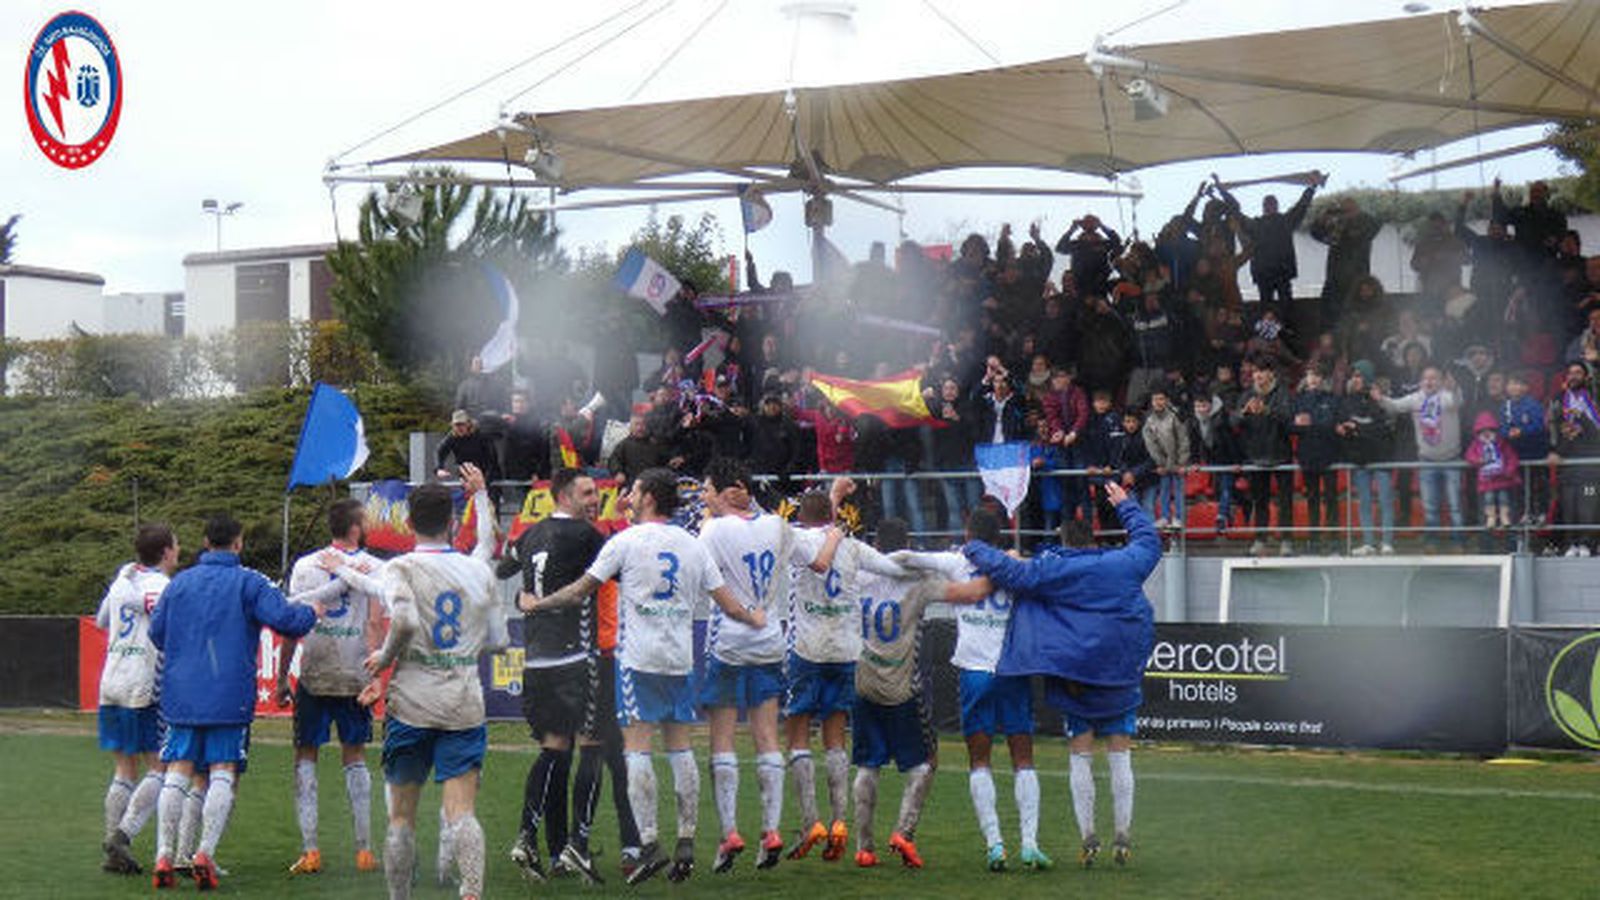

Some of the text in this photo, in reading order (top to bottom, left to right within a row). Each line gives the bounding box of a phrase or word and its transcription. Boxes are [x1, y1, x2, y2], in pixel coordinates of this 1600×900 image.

[531, 551, 549, 598] 1
[652, 551, 681, 600] 3
[742, 549, 777, 602] 18
[433, 590, 463, 650] 8
[860, 596, 901, 643] 10
[1146, 636, 1285, 673] ercotel
[1169, 680, 1238, 703] hotels
